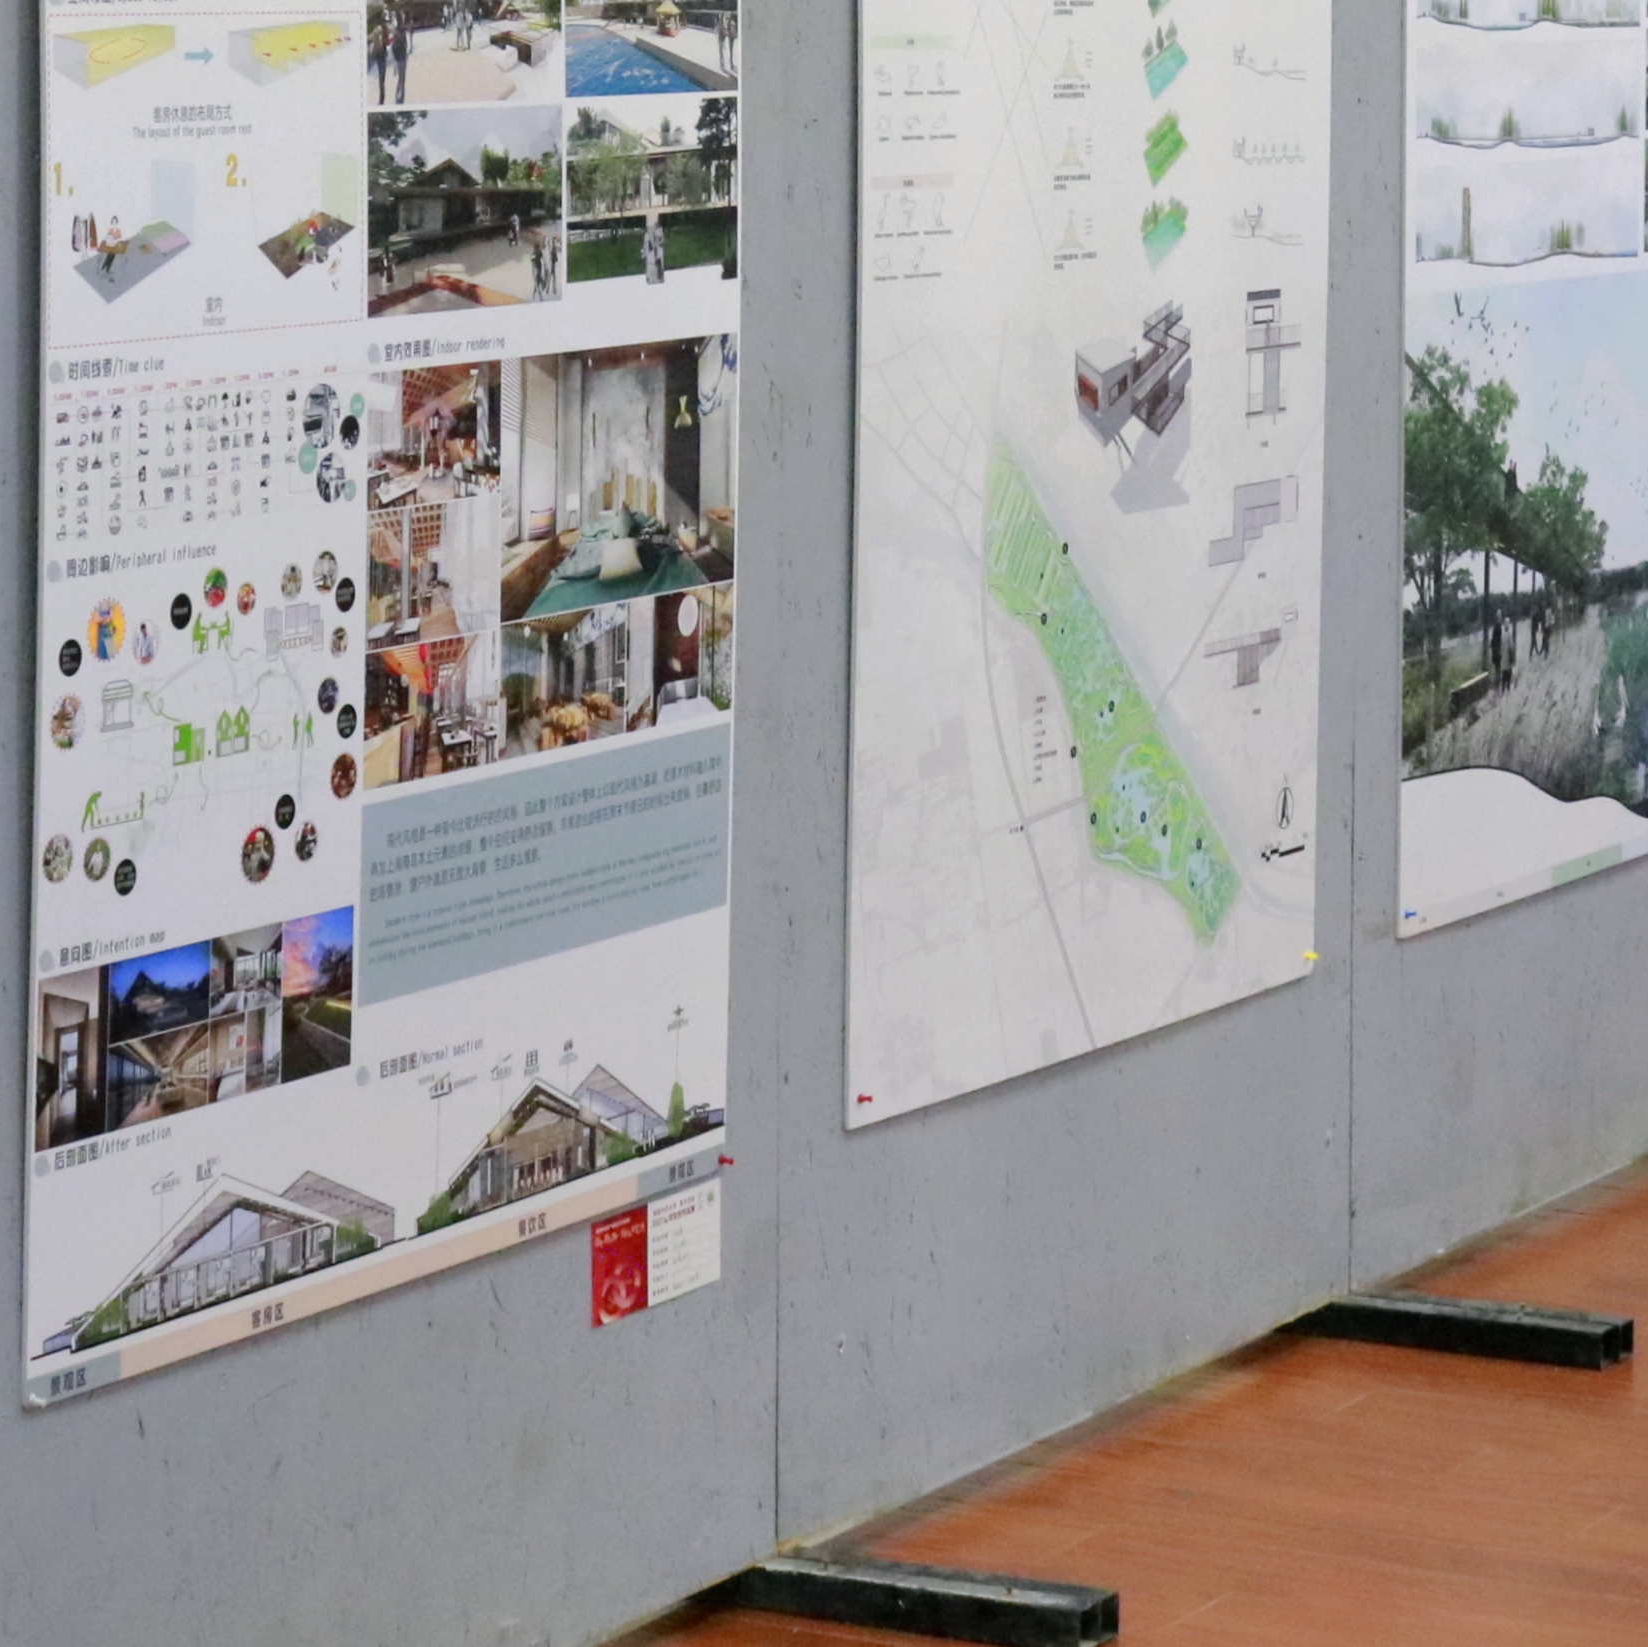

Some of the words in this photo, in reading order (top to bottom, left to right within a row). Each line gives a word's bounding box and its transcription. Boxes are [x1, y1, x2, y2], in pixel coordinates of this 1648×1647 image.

[53, 162, 75, 196] 1.
[226, 153, 247, 187] 2.
[144, 356, 165, 371] clue
[172, 543, 217, 563] influence
[149, 930, 166, 944] map
[452, 1036, 484, 1057] section
[134, 1126, 172, 1147] section
[251, 1302, 284, 1328] 客房区
